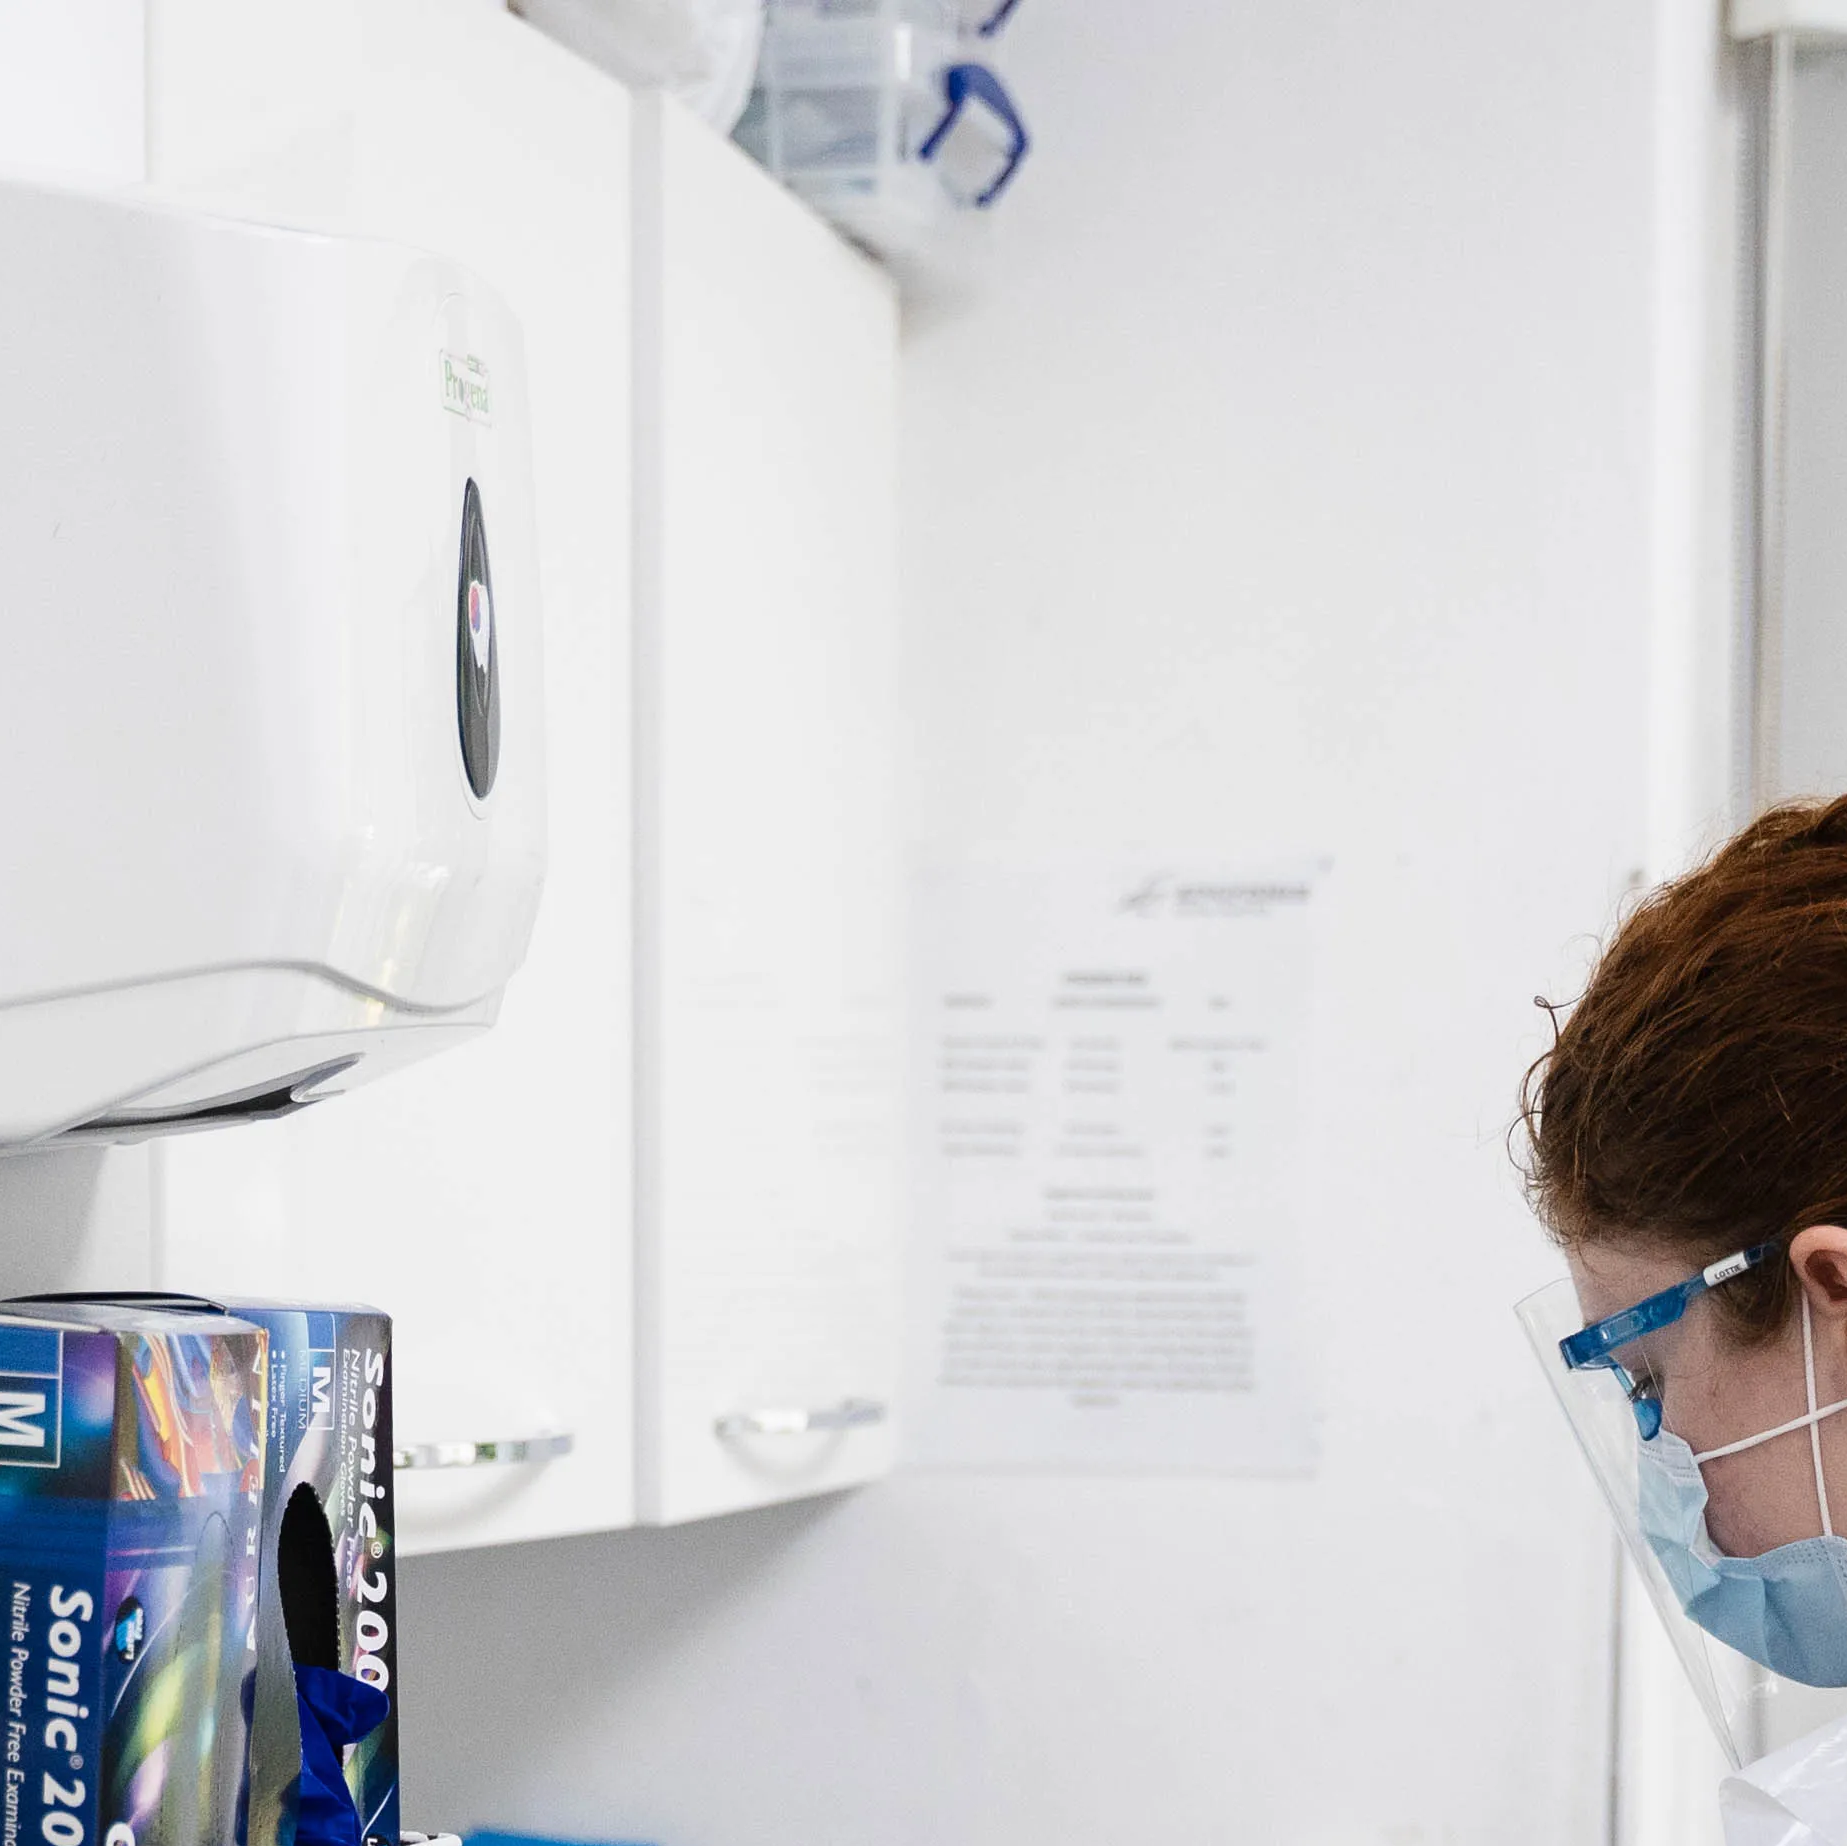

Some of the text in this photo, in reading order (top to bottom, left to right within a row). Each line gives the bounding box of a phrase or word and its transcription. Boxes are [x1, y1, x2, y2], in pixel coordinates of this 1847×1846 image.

[270, 1364, 279, 1439] Latex Free
[278, 1364, 287, 1473] Finger Textured
[298, 1350, 308, 1430] MEDIUM
[312, 1366, 331, 1413] M
[340, 1348, 350, 1456] Examination
[346, 1348, 361, 1589] Nitrile Powder Free
[11, 1582, 32, 1642] Nitrile
[355, 1571, 390, 1692] 200
[9, 1647, 30, 1717] Powder
[7, 1721, 27, 1762] Free
